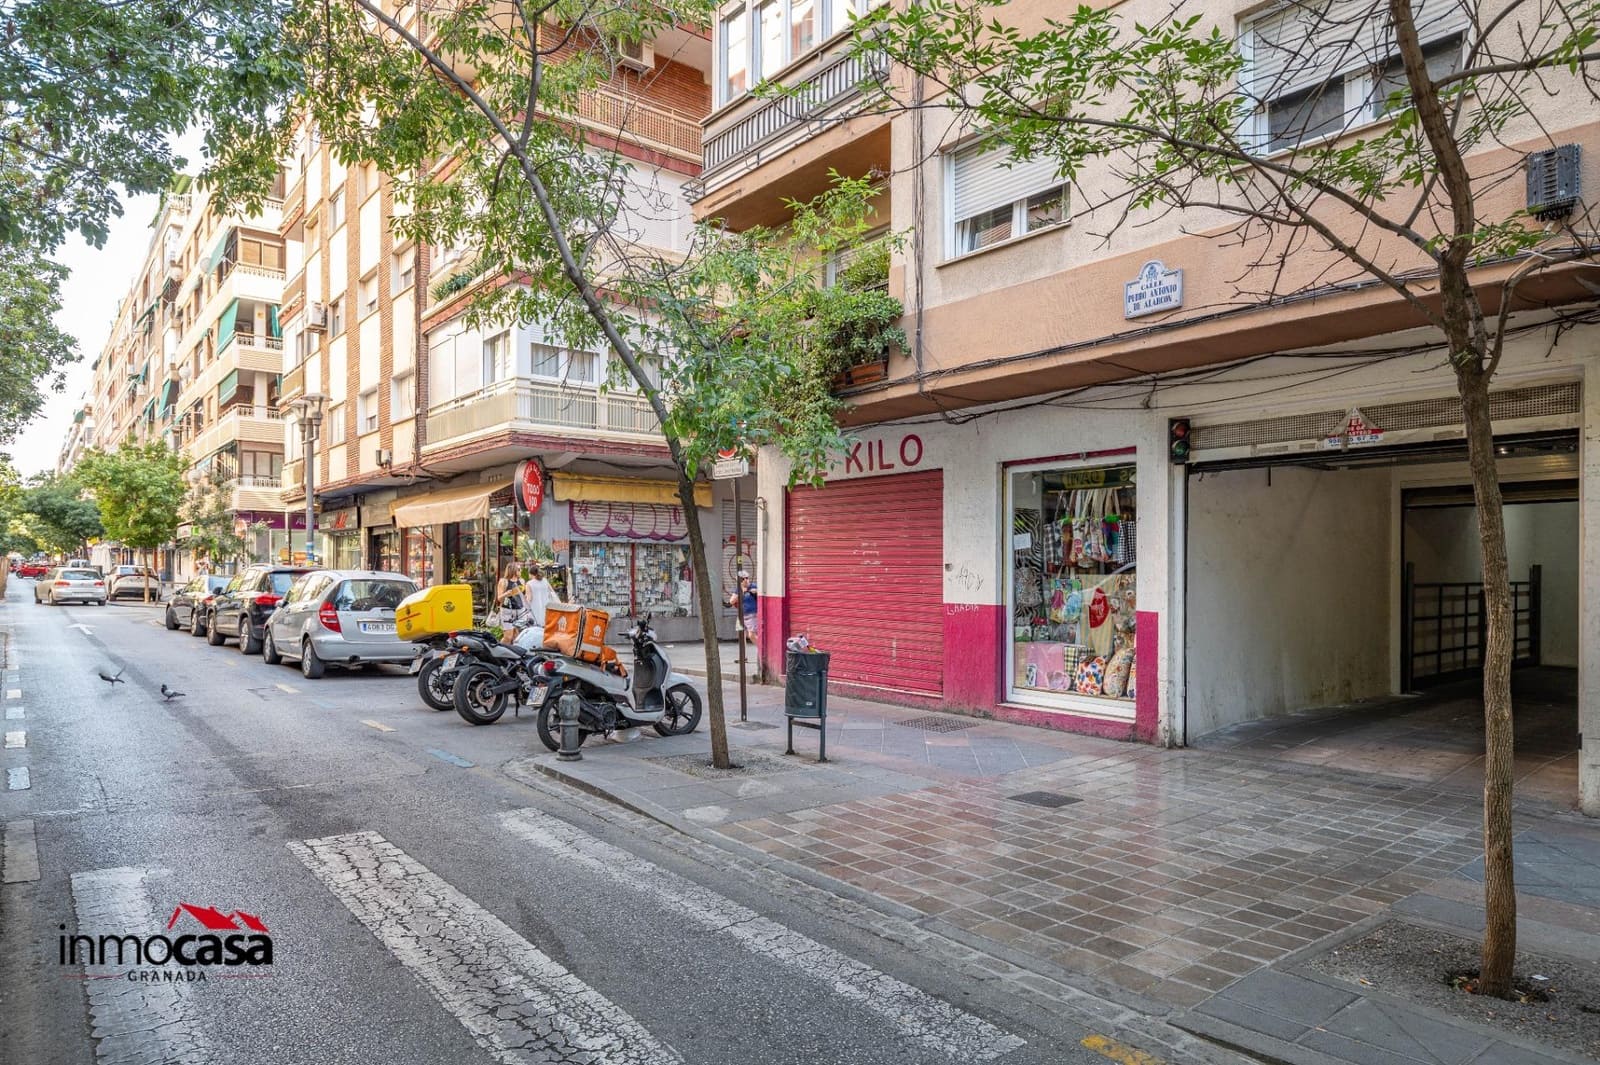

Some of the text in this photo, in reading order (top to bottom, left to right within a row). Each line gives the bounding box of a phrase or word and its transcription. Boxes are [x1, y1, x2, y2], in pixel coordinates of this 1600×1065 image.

[1128, 284, 1177, 303] PEDRO ANTONIO
[1140, 280, 1162, 290] CALLE
[845, 433, 924, 475] KILO
